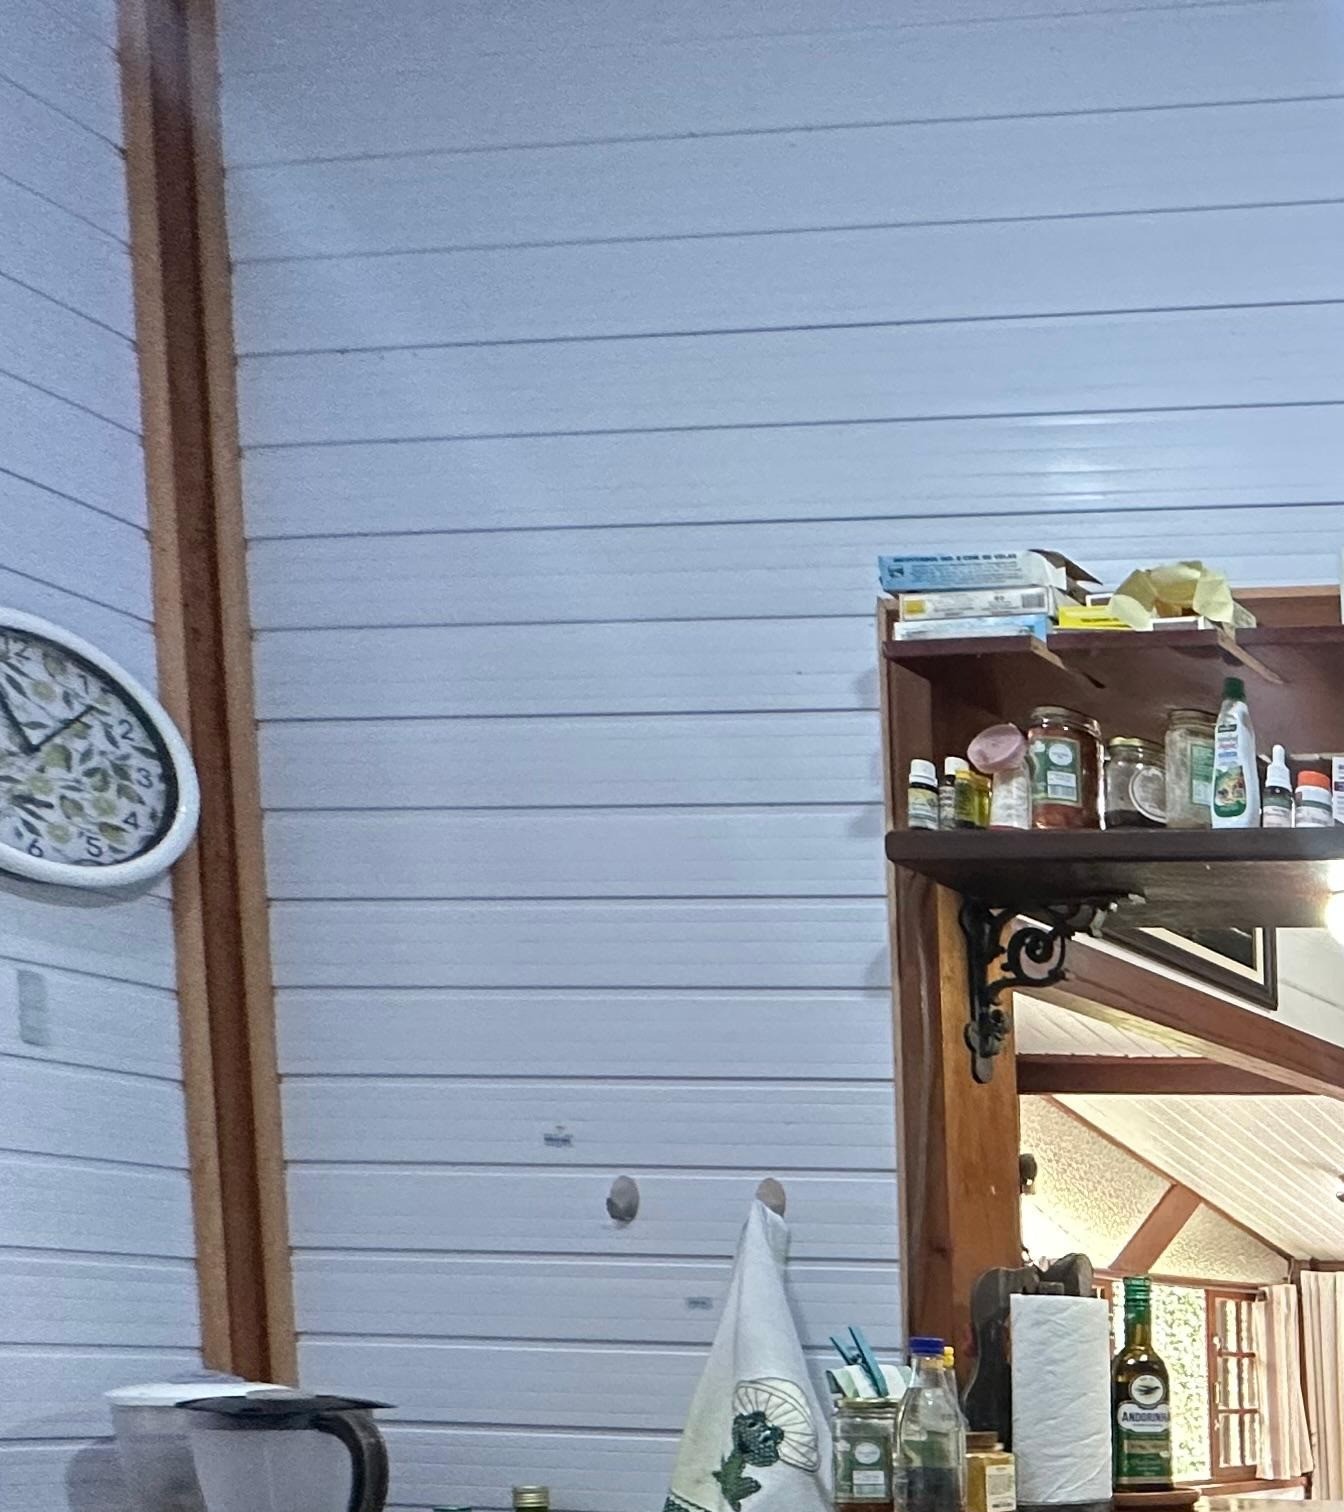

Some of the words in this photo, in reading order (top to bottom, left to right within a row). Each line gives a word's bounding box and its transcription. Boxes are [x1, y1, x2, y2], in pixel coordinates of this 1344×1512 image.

[78, 674, 91, 696] 1
[118, 719, 136, 742] 2
[136, 767, 154, 790] 3
[123, 810, 142, 831] 4
[28, 838, 46, 860] 6
[85, 836, 104, 859] 5
